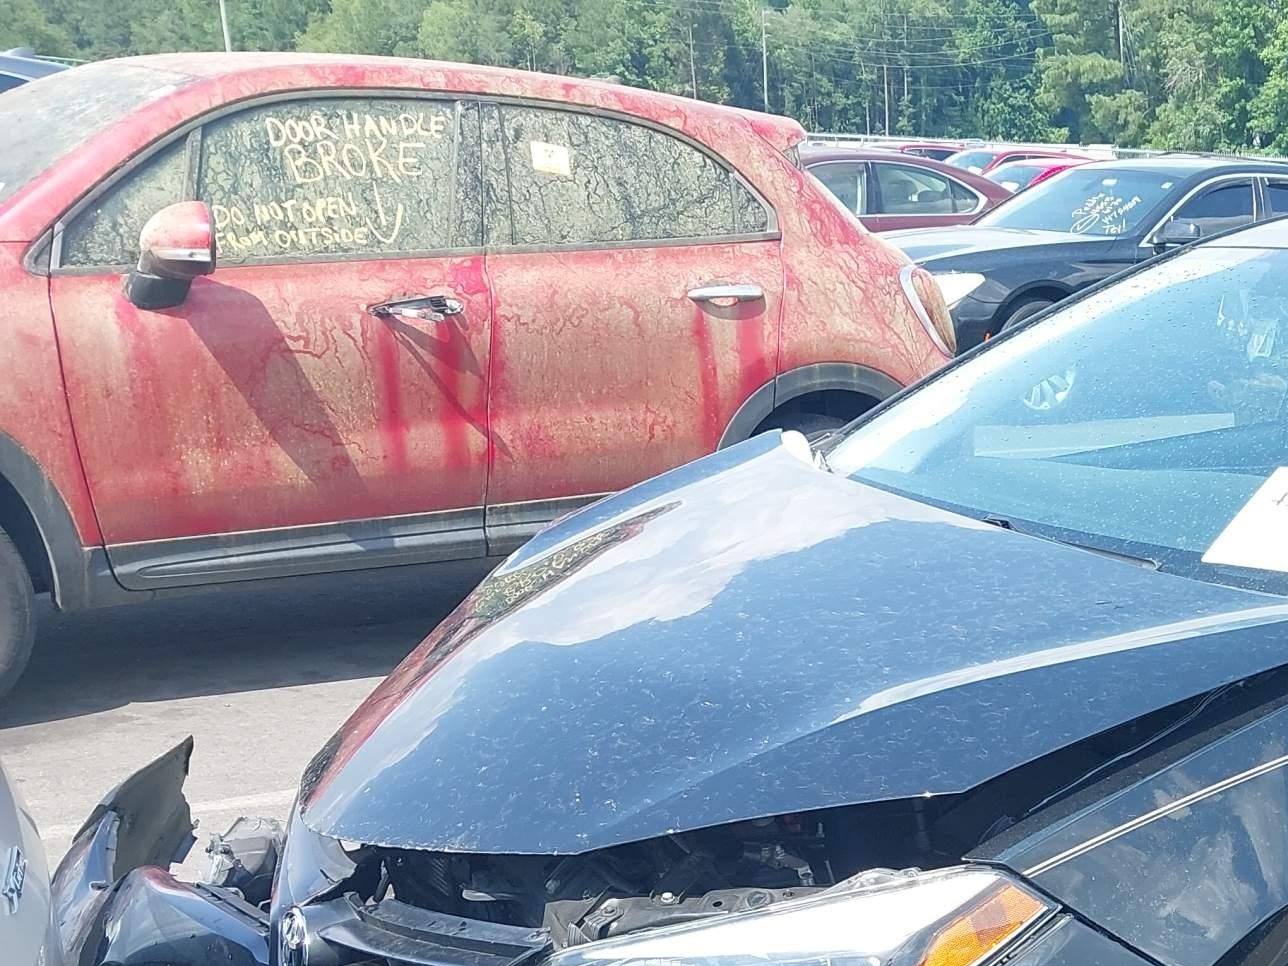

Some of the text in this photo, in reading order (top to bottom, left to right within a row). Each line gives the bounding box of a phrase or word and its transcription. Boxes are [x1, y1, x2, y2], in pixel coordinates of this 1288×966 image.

[264, 112, 446, 146] DOOR HANDLE
[284, 138, 426, 184] BROKE
[212, 196, 357, 228] DO NOT OPEN
